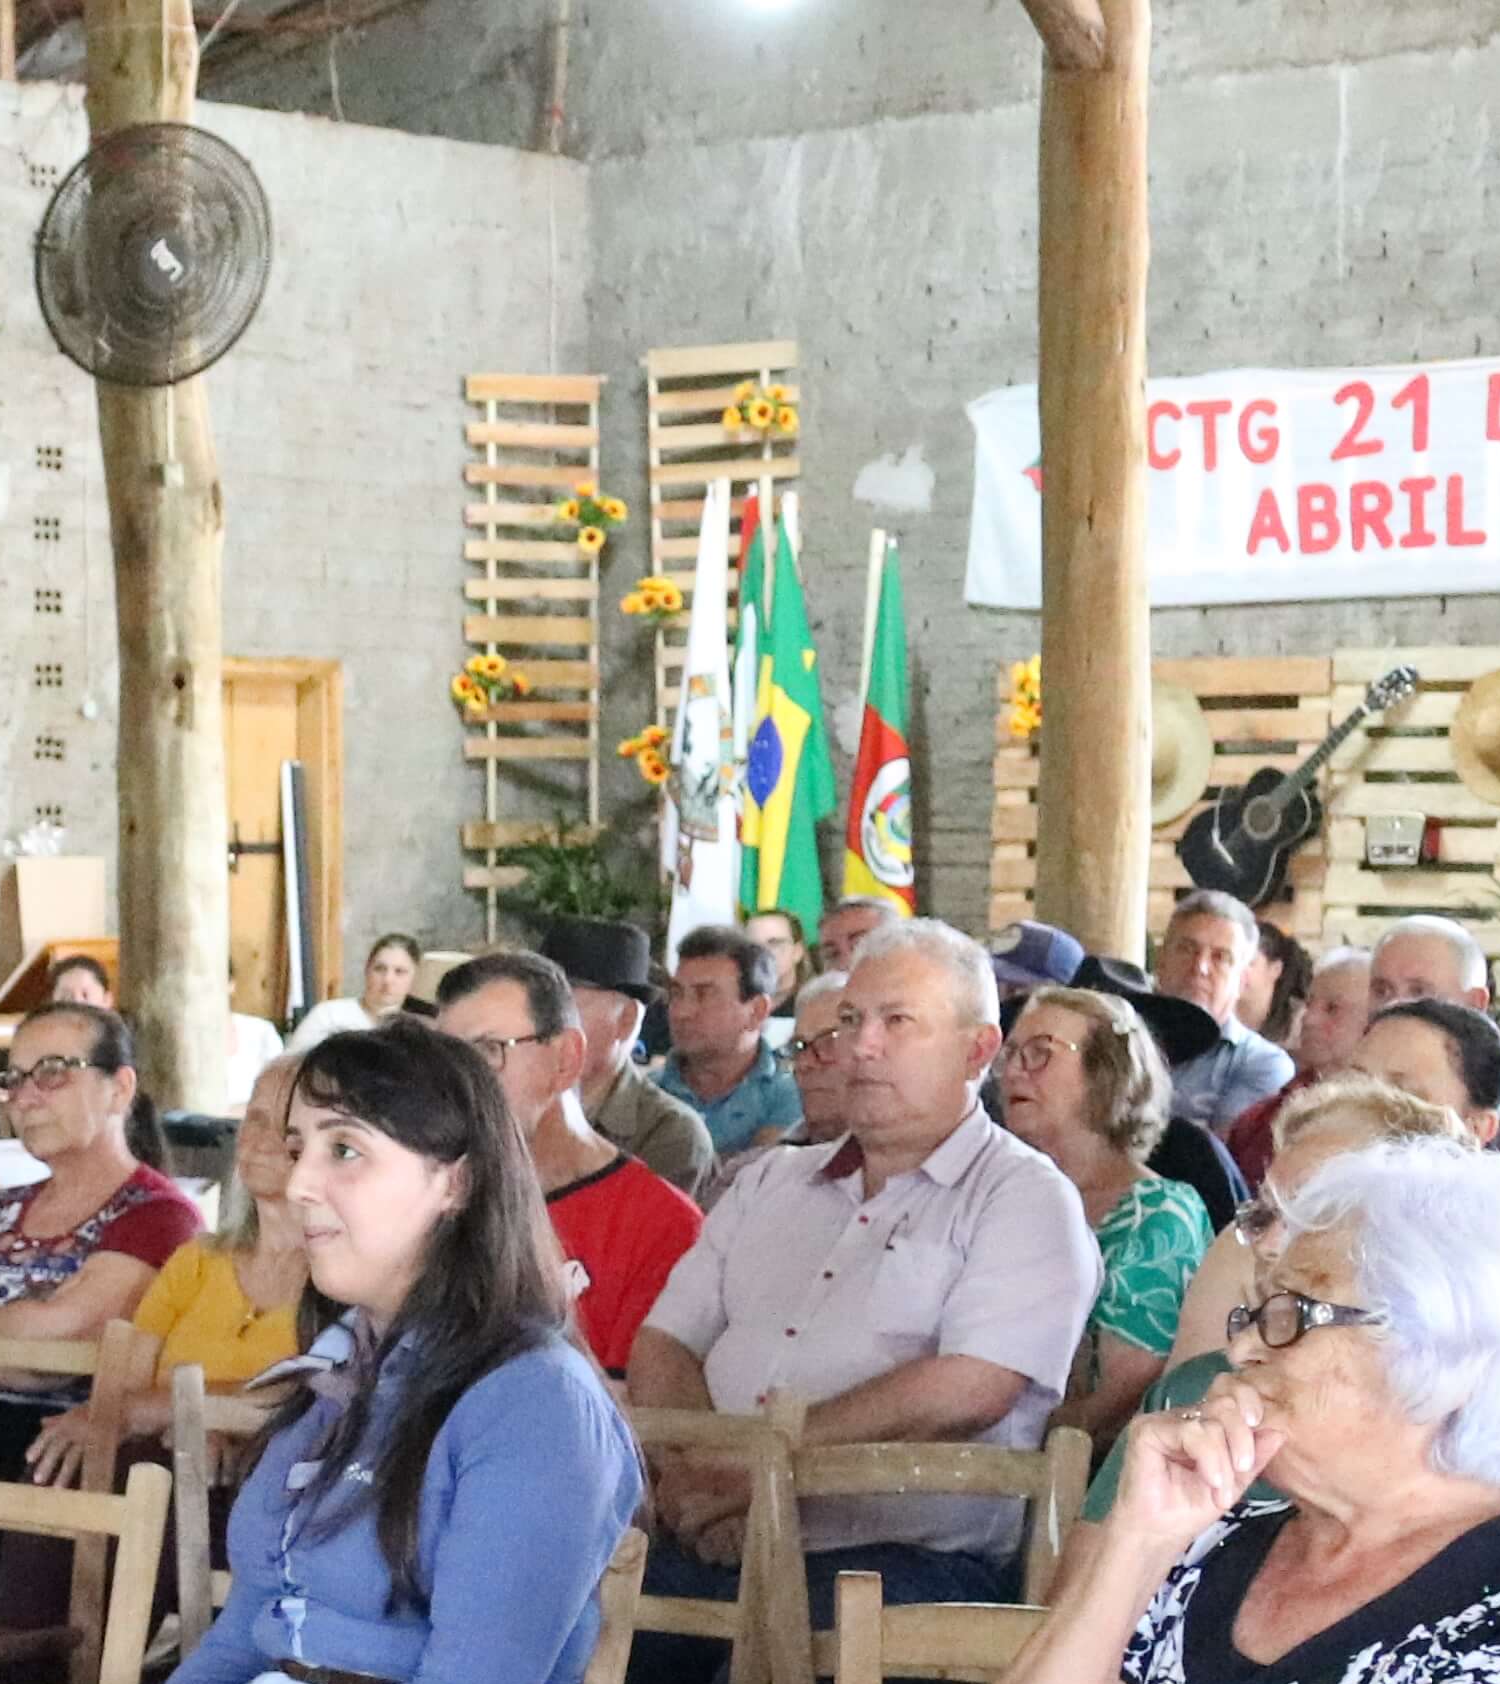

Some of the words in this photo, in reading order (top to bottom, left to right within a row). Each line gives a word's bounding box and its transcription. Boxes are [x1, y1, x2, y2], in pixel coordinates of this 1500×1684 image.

[1147, 399, 1281, 472] CTG
[1331, 373, 1431, 461] 21
[1247, 473, 1488, 556] ABRIL
